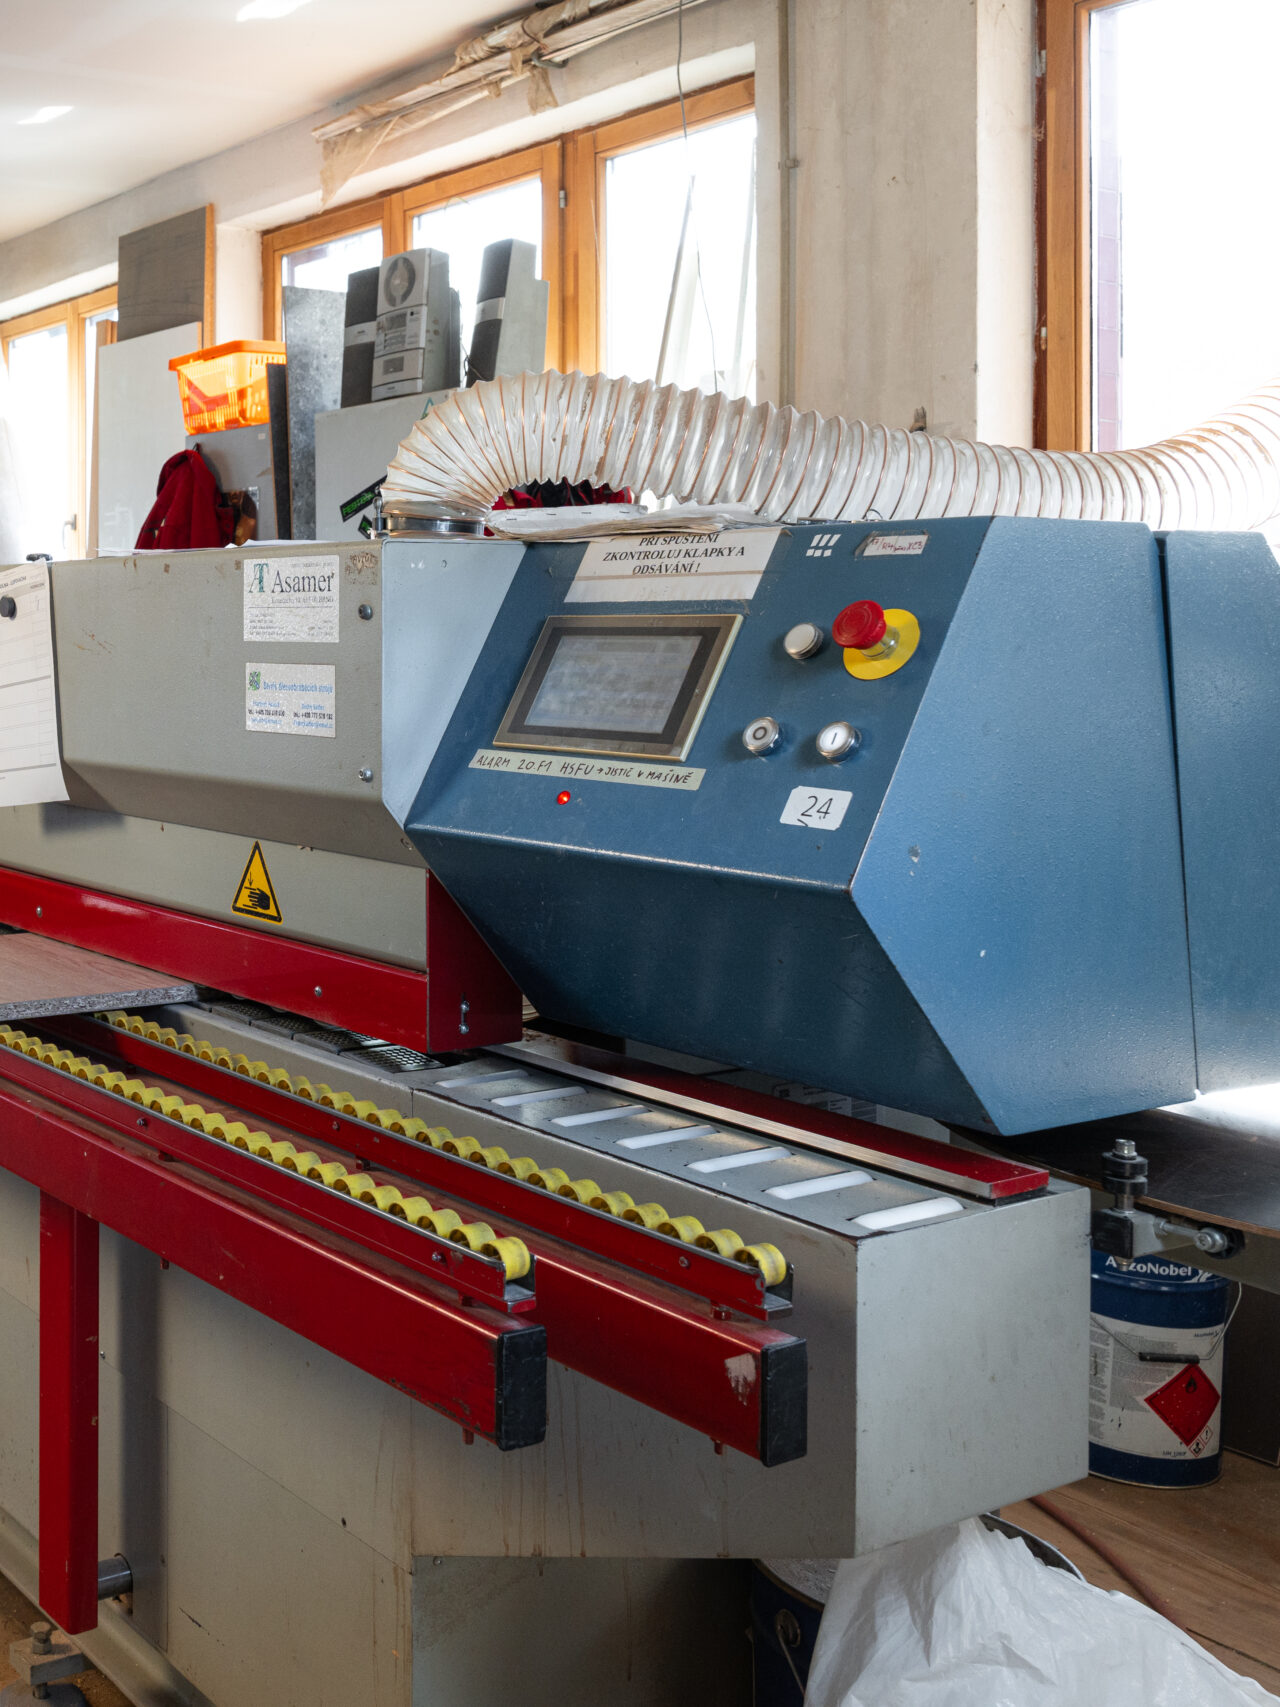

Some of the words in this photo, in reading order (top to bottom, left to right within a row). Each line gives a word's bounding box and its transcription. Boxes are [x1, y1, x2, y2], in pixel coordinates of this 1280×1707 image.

[639, 535, 660, 546] PŘI
[602, 550, 681, 562] ZKONTROLUJ
[683, 547, 736, 559] KLAPKY
[735, 546, 745, 556] A
[632, 562, 694, 575] ODSÁVÁNÍ
[271, 570, 332, 593] Asamer
[477, 755, 511, 769] ALARM
[800, 795, 834, 819] 24
[1105, 1255, 1192, 1277] AzoNobel
